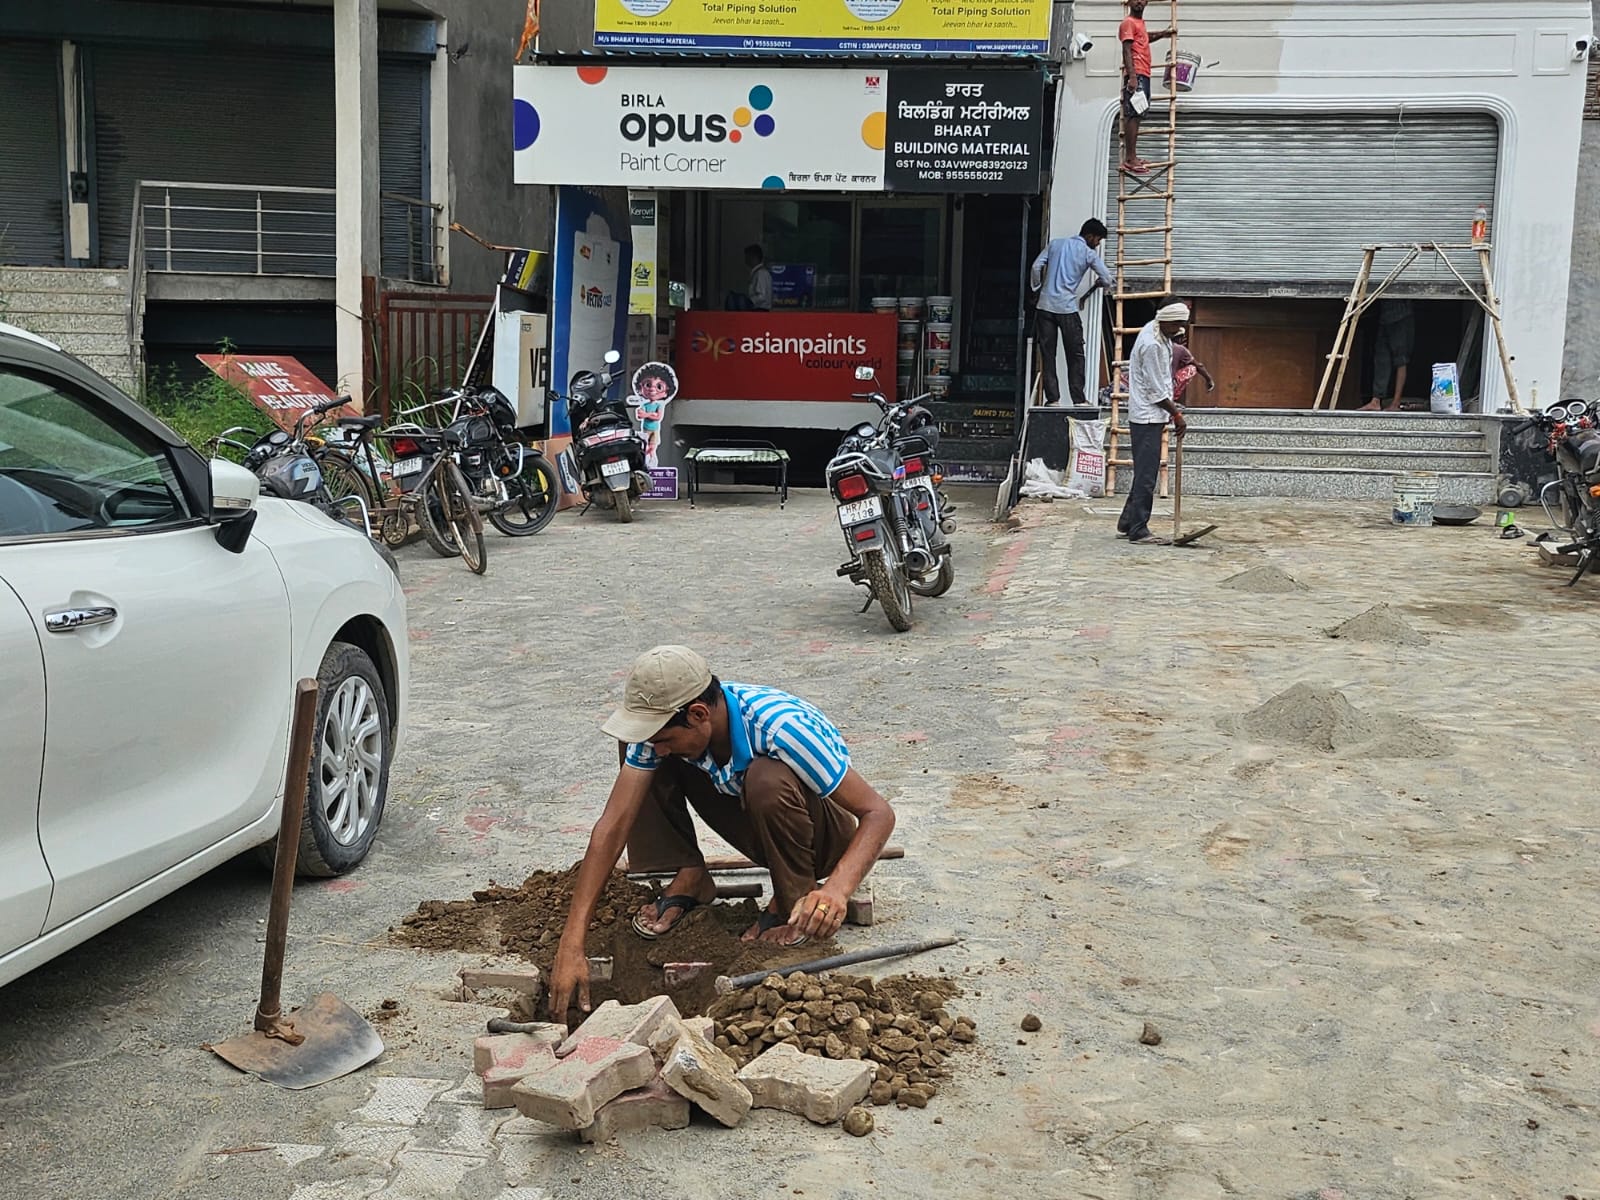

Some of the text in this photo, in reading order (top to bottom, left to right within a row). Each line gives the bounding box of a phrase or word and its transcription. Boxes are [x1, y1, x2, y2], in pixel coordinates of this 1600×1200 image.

[703, 4, 797, 15] Total Piping Solution
[932, 7, 1030, 17] Total Piping Solution
[610, 36, 635, 44] BHARAT
[636, 36, 665, 44] BUILDING
[666, 37, 696, 45] MATERIAL
[743, 39, 754, 48] (M)
[945, 83, 984, 97] ਭਾਰਤ
[621, 94, 666, 108] BIRLA
[898, 100, 1031, 120] ਬਿਲਡਿੰਗ ਮਟੀਰੀਅਲ
[934, 125, 991, 137] BHARAT
[894, 142, 1030, 155] BUILDING MATERIAL
[620, 152, 726, 173] Paint Corner
[896, 160, 1028, 170] GST No. 03AVWPG8392G1Z3
[918, 172, 1003, 180] MOB: 9555550212
[740, 331, 866, 364] asianpaints
[236, 362, 289, 378] MAKE
[264, 378, 302, 393] LIFE
[845, 498, 874, 514] HR71K
[850, 508, 875, 522] 2138
